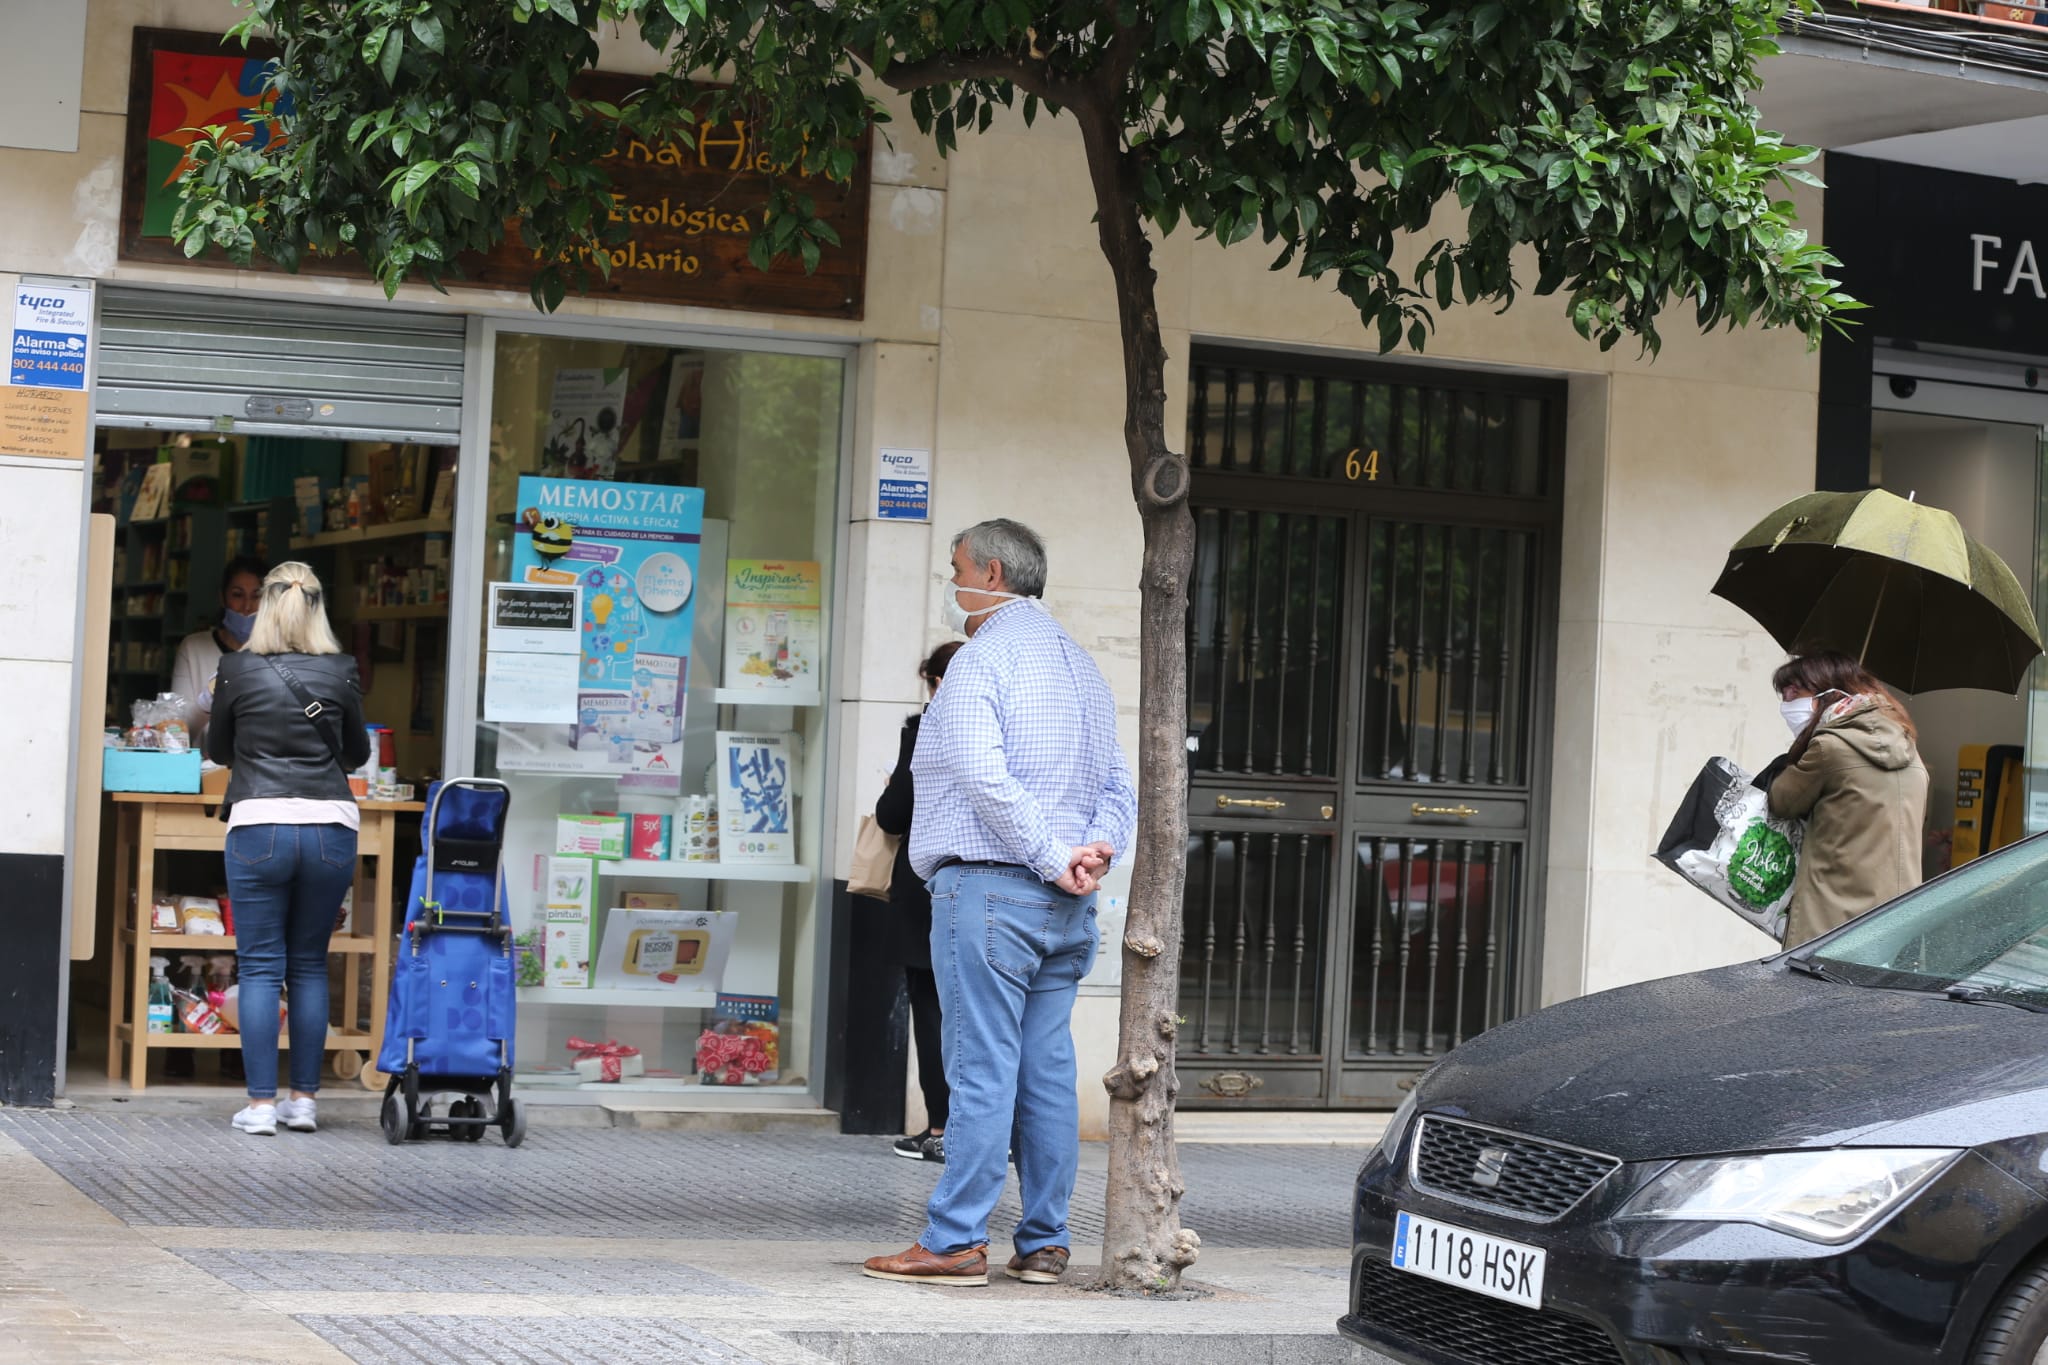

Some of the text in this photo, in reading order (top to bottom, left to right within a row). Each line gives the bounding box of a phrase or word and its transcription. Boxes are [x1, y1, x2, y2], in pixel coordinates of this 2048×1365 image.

[607, 192, 750, 235] Ecológica
[1970, 233, 2047, 299] FA
[19, 294, 65, 310] tyco
[39, 309, 75, 318] Integrated
[57, 318, 85, 327] Security
[15, 335, 66, 350] Alarma
[31, 348, 51, 356] aviso
[59, 349, 84, 358] policía
[13, 359, 83, 374] 902 444 440
[882, 453, 913, 465] tyco
[1345, 448, 1380, 481] 64
[880, 483, 914, 493] Alarma
[538, 484, 685, 514] MEMOSTAR
[592, 514, 630, 527] ACTIVA
[643, 516, 680, 529] EFICAZ
[604, 530, 630, 539] CUIDADO
[1744, 840, 1791, 875] Hola!
[1415, 1224, 1536, 1298] 1118 HSK
